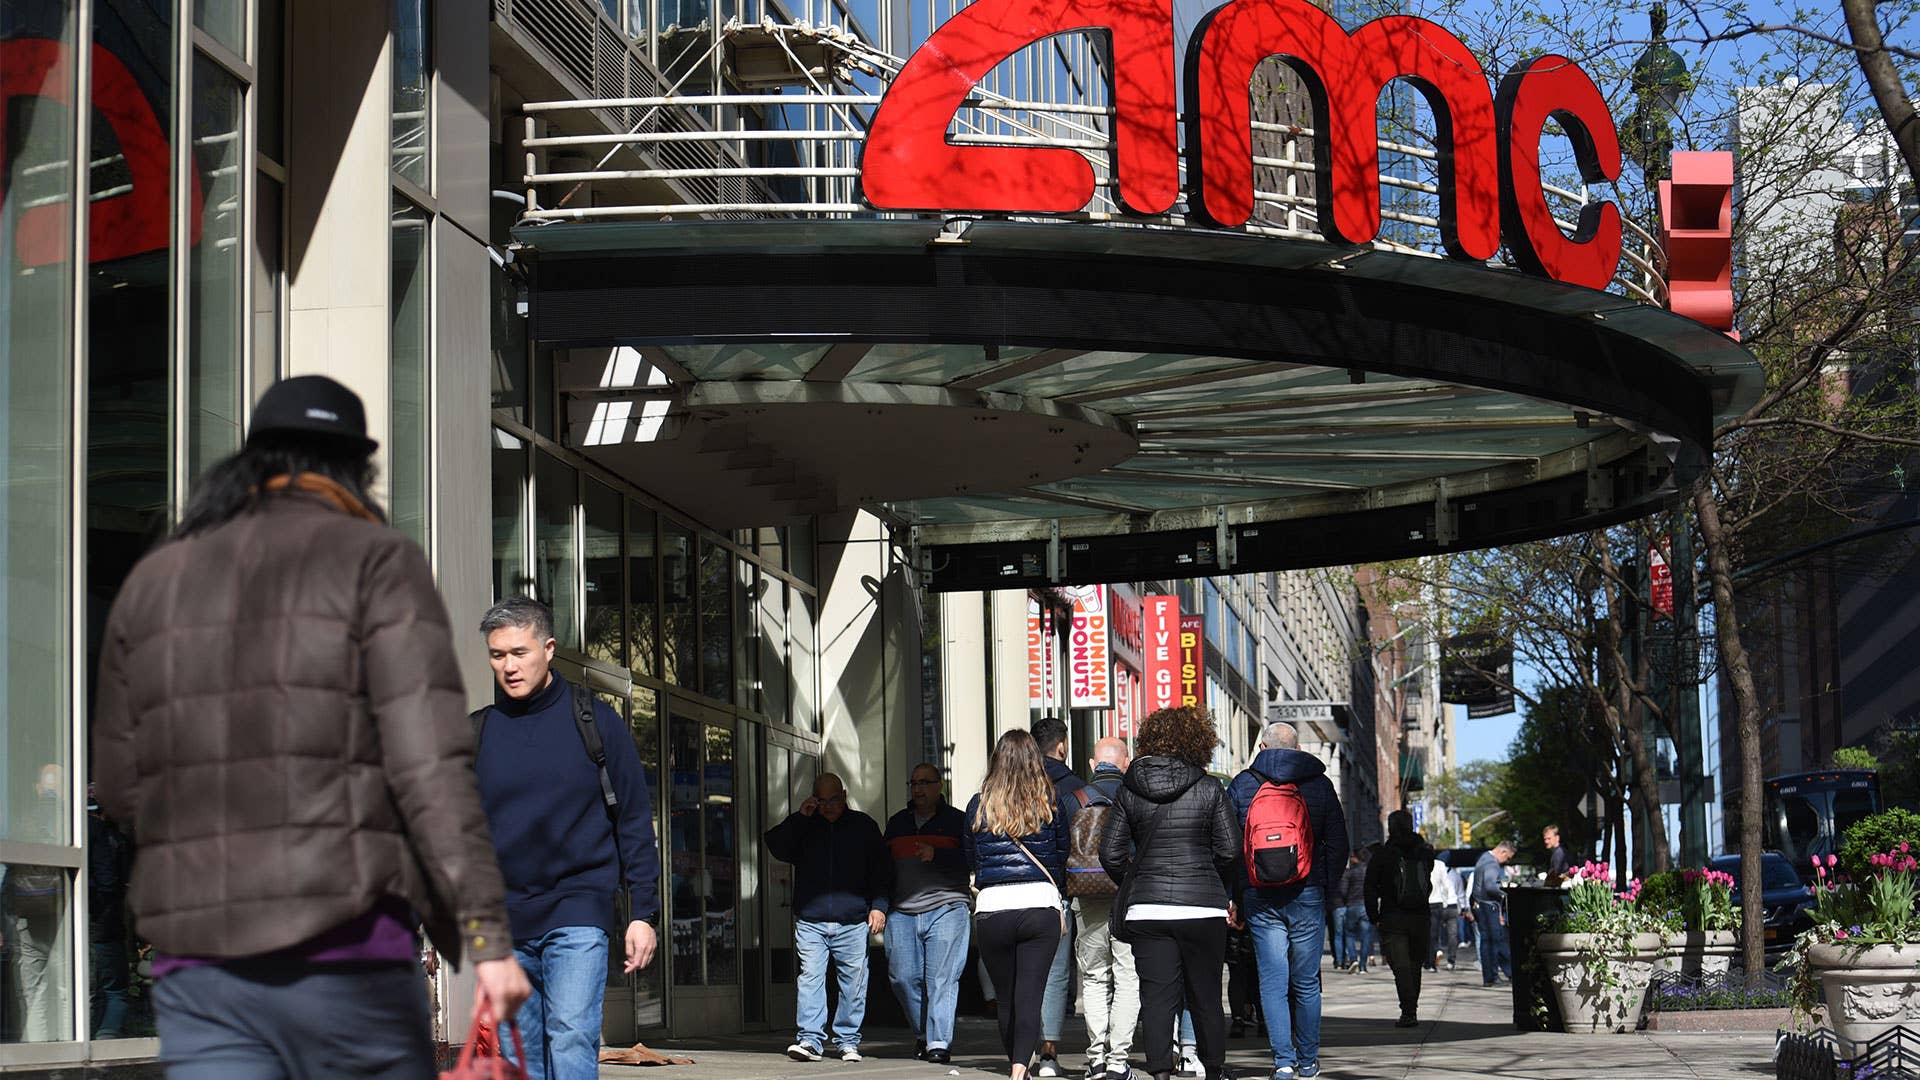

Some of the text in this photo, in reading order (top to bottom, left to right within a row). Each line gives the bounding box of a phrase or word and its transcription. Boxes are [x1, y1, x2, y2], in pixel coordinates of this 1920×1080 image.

[861, 0, 1624, 290] amc
[1072, 617, 1089, 698] DONUTS
[1156, 601, 1169, 660] FIVE
